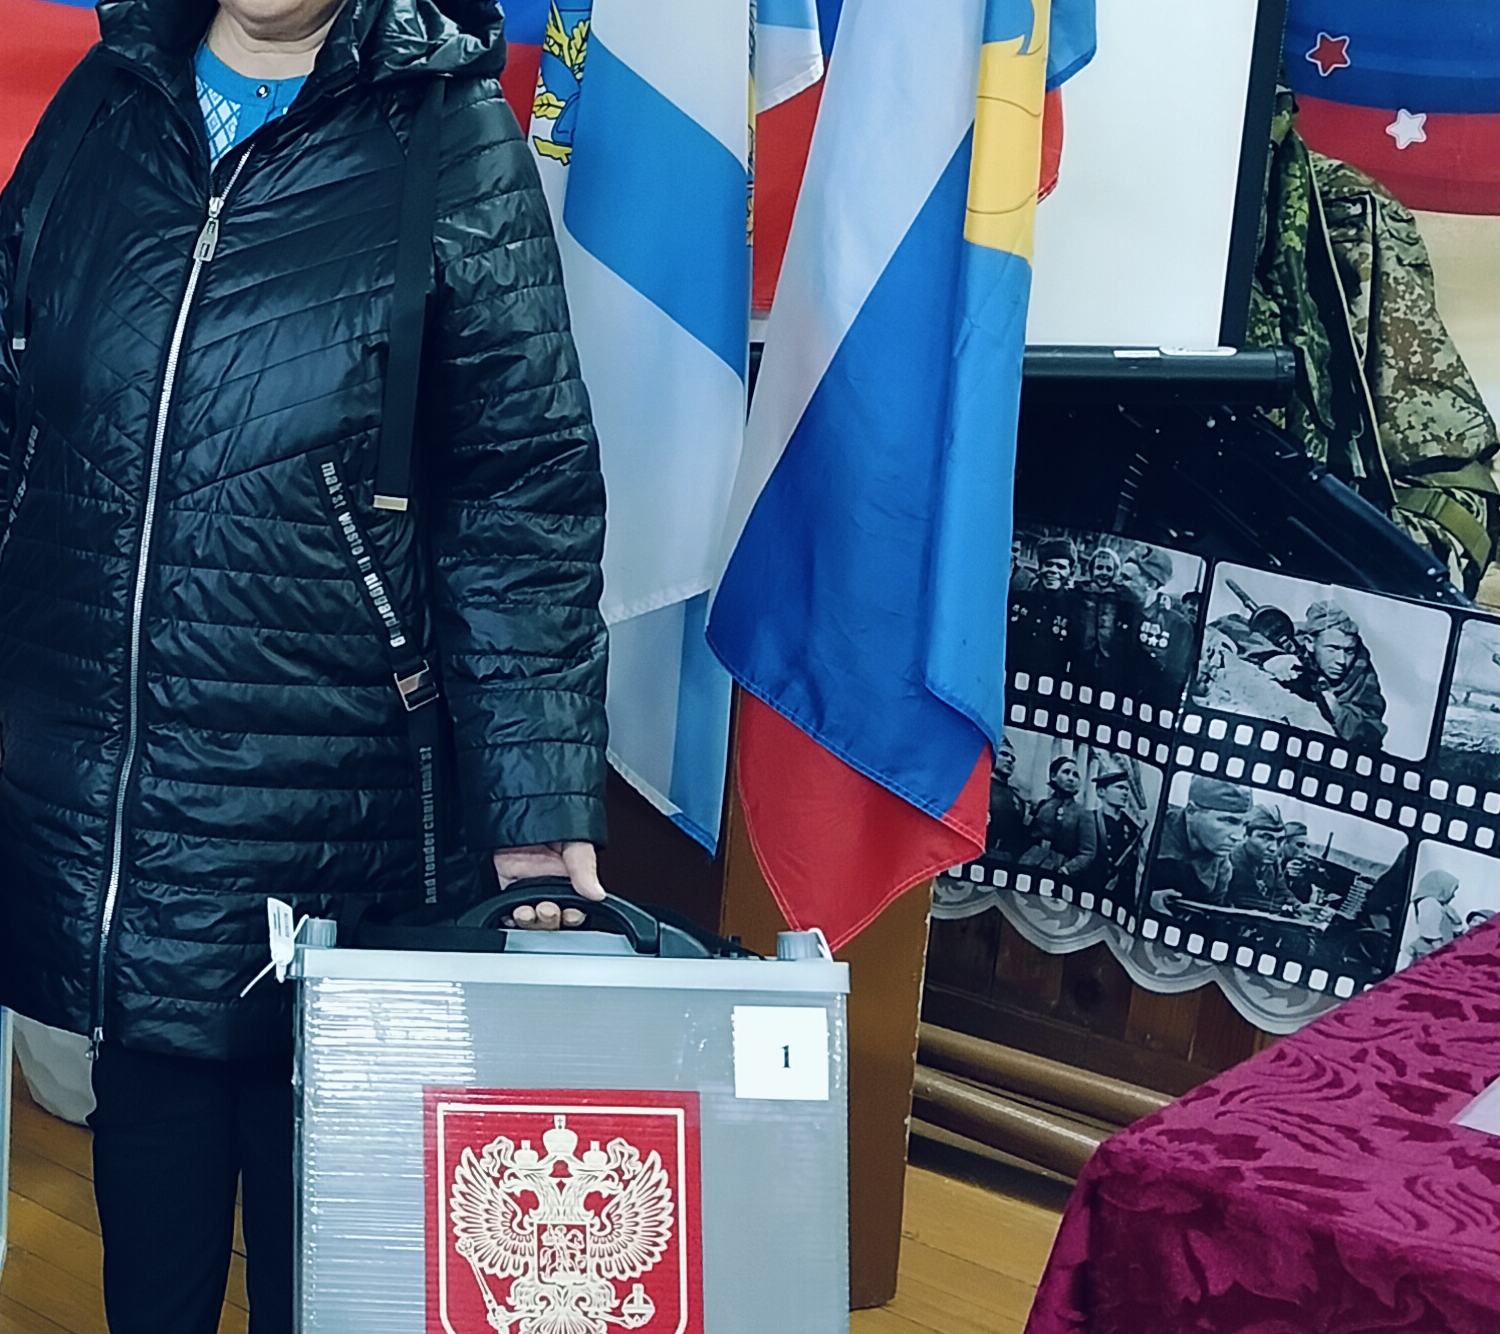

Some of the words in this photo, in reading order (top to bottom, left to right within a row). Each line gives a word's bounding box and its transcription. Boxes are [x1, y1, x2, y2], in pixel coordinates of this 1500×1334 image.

[420, 793, 435, 831] churl
[422, 832, 436, 877] tender
[424, 877, 438, 904] And
[780, 1044, 792, 1069] 1
